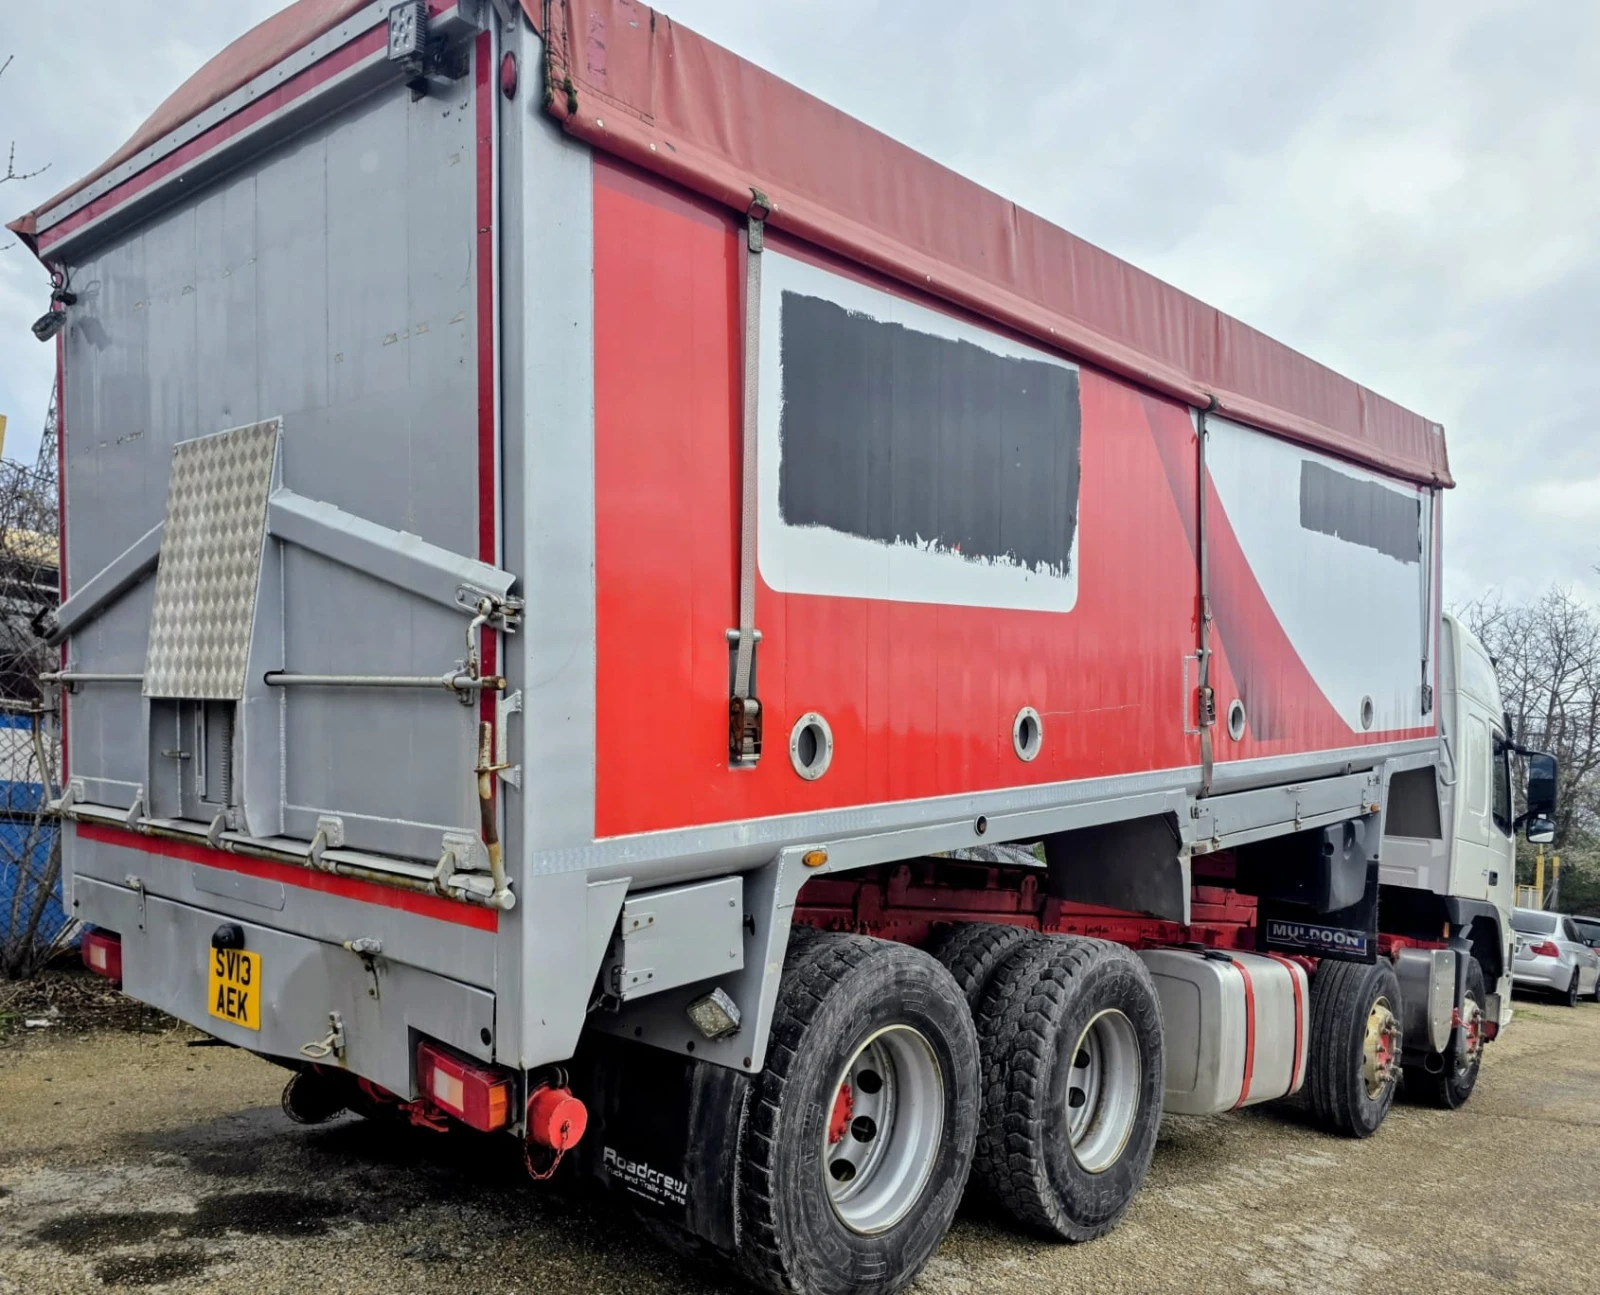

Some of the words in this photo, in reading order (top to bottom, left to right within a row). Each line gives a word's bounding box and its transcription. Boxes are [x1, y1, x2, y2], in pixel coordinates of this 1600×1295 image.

[216, 947, 251, 986] SV13
[216, 984, 248, 1022] AEK
[603, 1145, 688, 1196] Roadcrew
[603, 1163, 623, 1178] Truck
[624, 1174, 638, 1185] and
[663, 1189, 686, 1205] Parts
